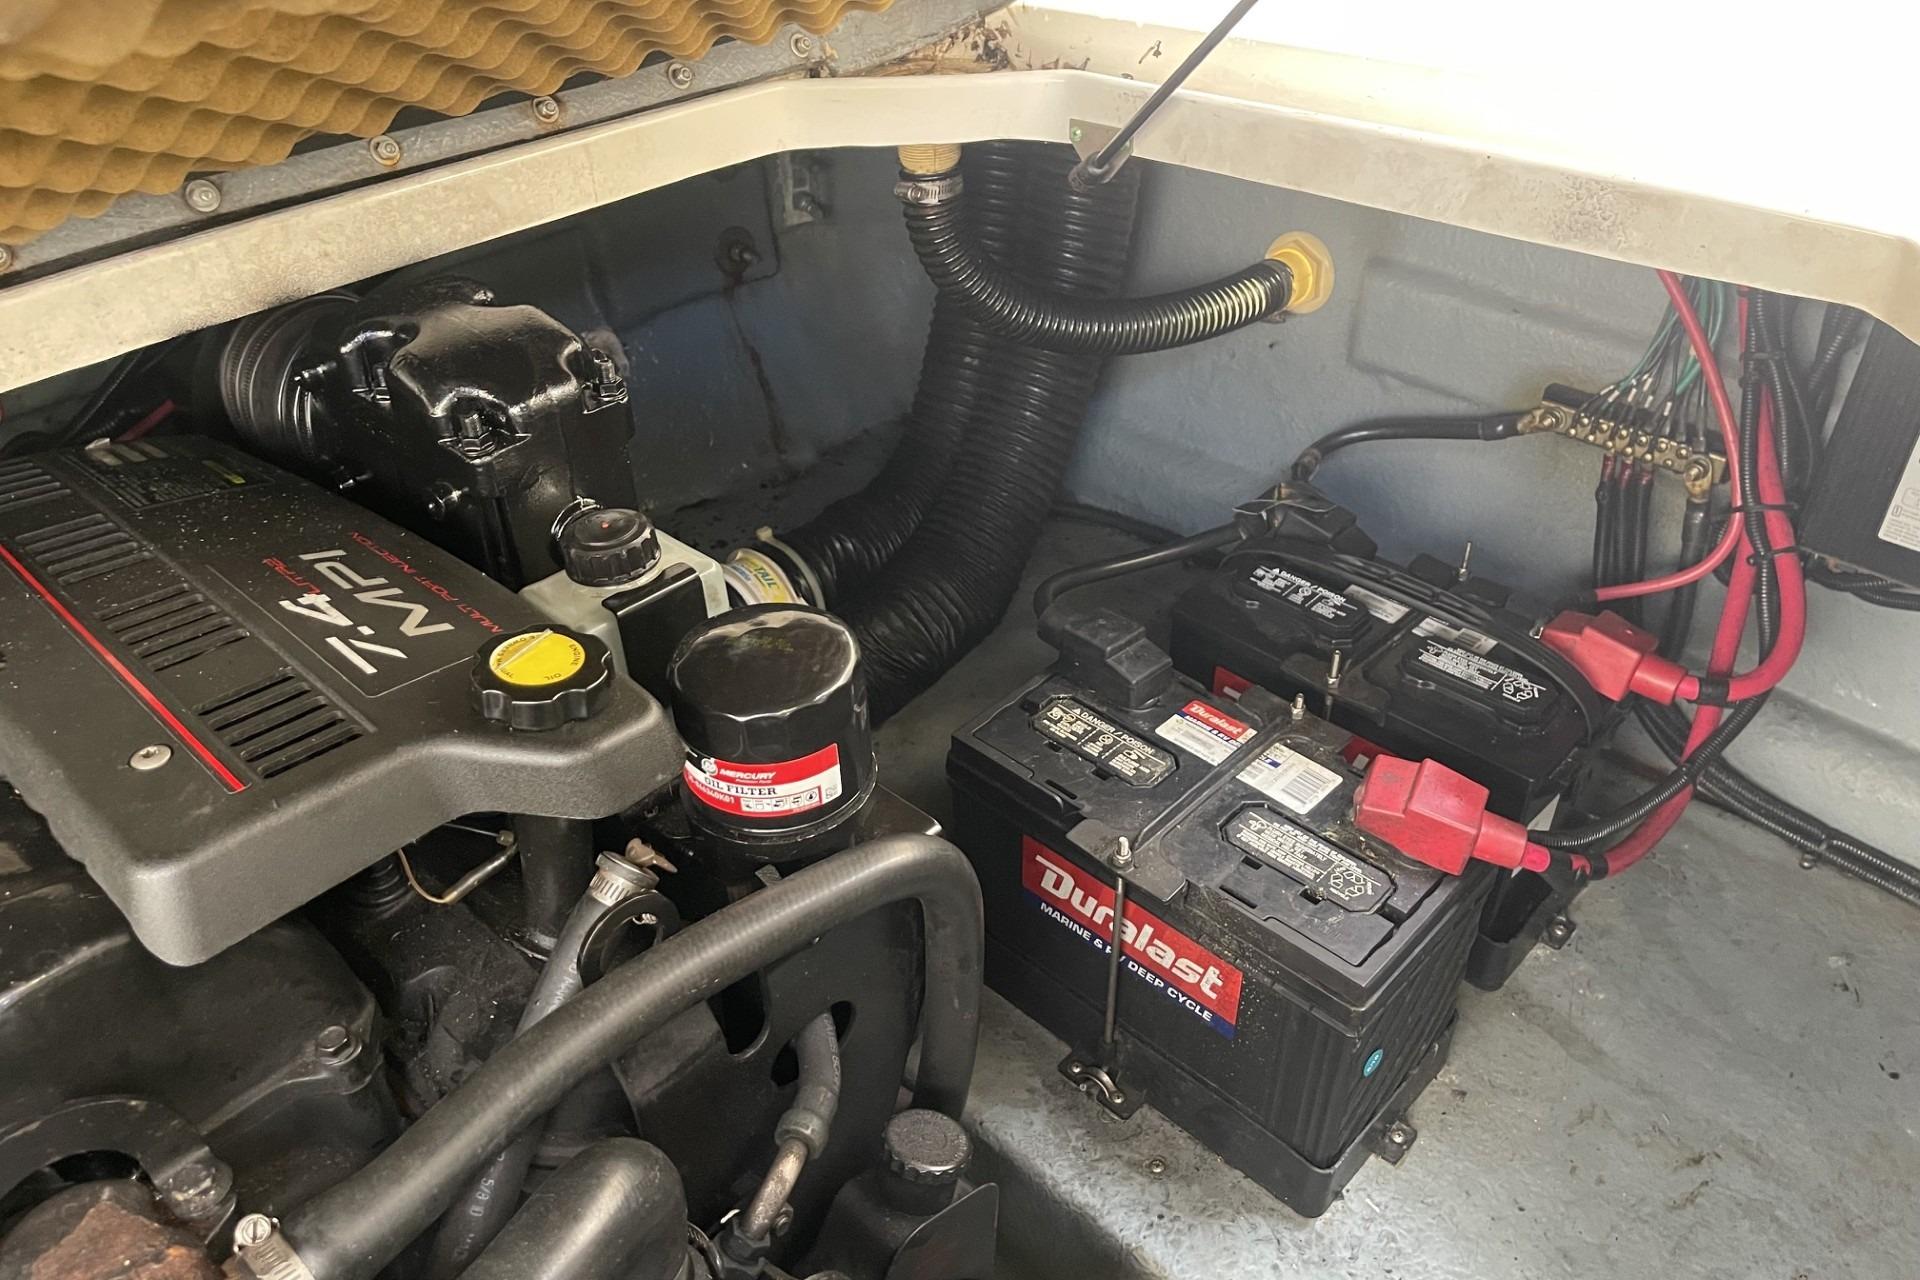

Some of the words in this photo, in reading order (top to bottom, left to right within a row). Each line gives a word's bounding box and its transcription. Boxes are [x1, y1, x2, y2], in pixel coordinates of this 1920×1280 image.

[351, 531, 417, 575] INJECTION
[298, 550, 455, 637] MPI
[413, 575, 458, 603] PORT
[457, 604, 503, 634] MULTI
[544, 672, 562, 681] OIL
[1081, 712, 1116, 733] DANGER
[1121, 734, 1156, 754] POISON
[1190, 704, 1244, 736] Duralast
[704, 777, 724, 790] OIL
[727, 785, 778, 796] FILTER
[719, 769, 776, 780] MERCURY
[1035, 855, 1224, 1000] Duralast
[1040, 902, 1091, 941] MARINE
[1093, 938, 1103, 949] &
[1128, 961, 1165, 988] DEEP
[1167, 987, 1214, 1022] CYCLE
